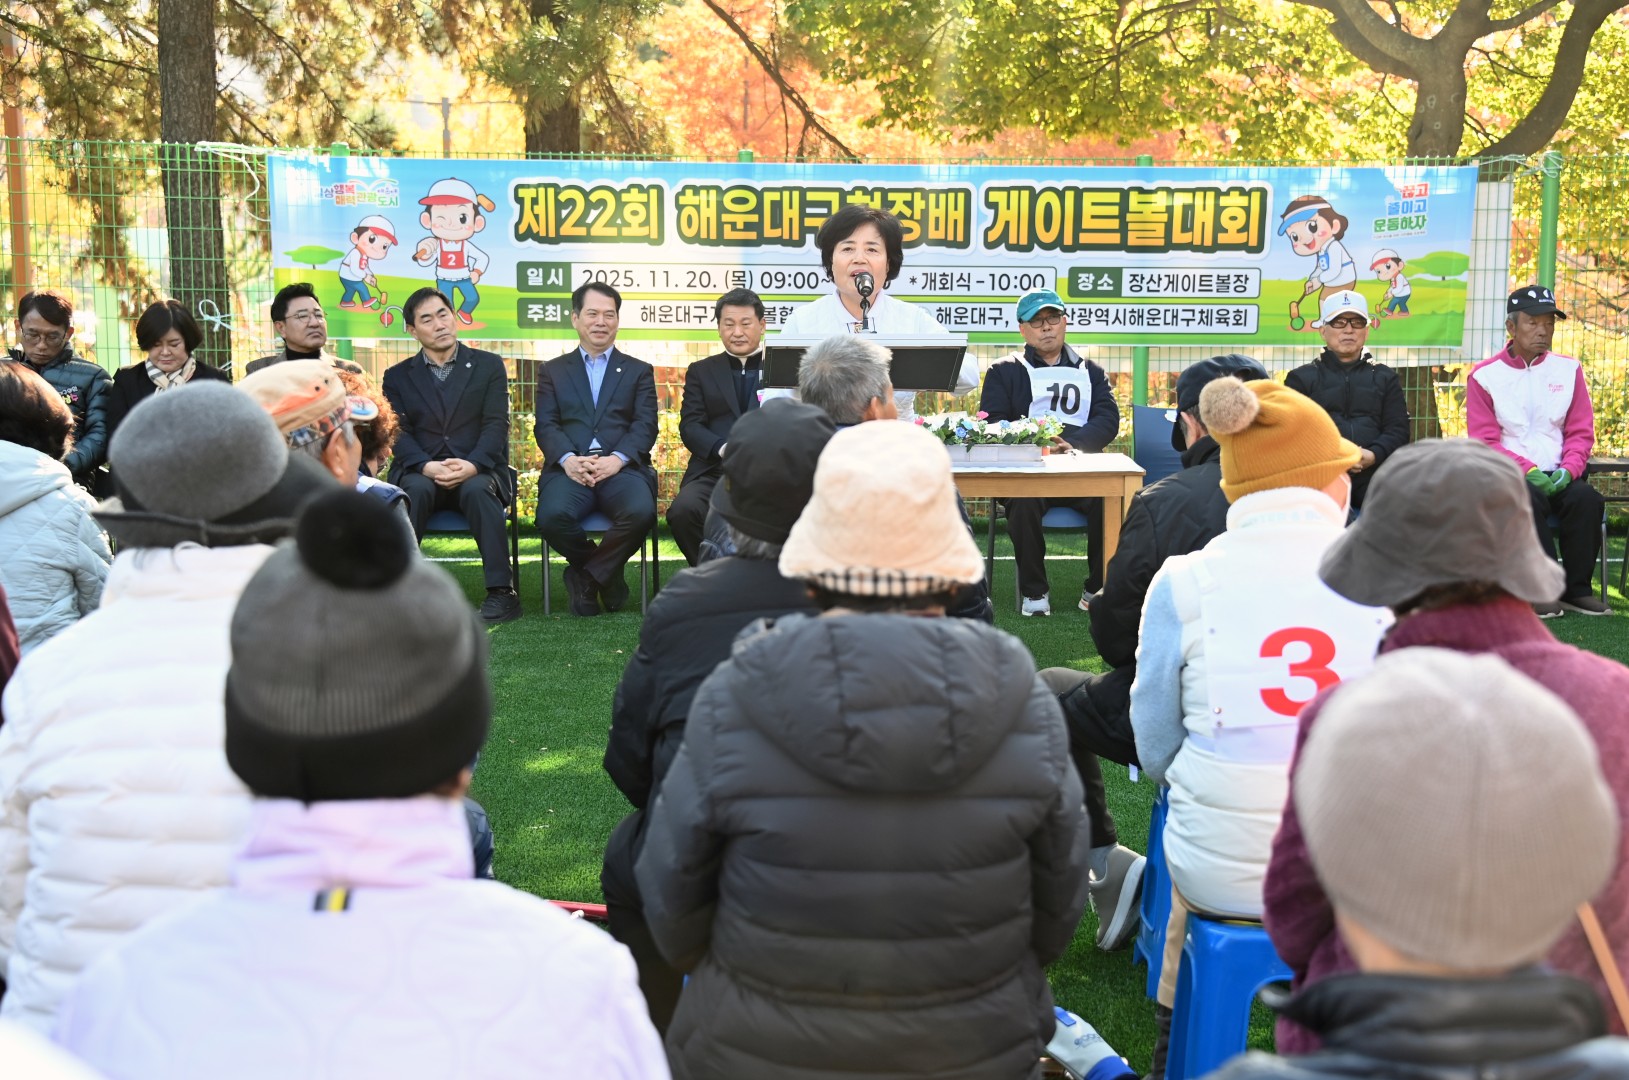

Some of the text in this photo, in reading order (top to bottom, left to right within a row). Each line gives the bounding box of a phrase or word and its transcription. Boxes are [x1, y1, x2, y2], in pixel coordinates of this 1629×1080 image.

[518, 186, 658, 240] 제22회
[987, 189, 1261, 247] 게이트볼대회
[1387, 198, 1427, 216] 줄이고
[1374, 214, 1427, 233] 운동하자
[447, 253, 456, 266] 2
[582, 269, 640, 288] 2025.
[650, 270, 679, 288] 11.
[686, 270, 717, 289] 20.
[725, 269, 754, 290] (목)
[1128, 273, 1250, 294] 장산게이트볼장
[936, 306, 1009, 328] 해운대구,
[1063, 307, 1248, 328] 산광역시해운대구체육회
[1046, 382, 1081, 415] 10
[1259, 626, 1342, 717] 3
